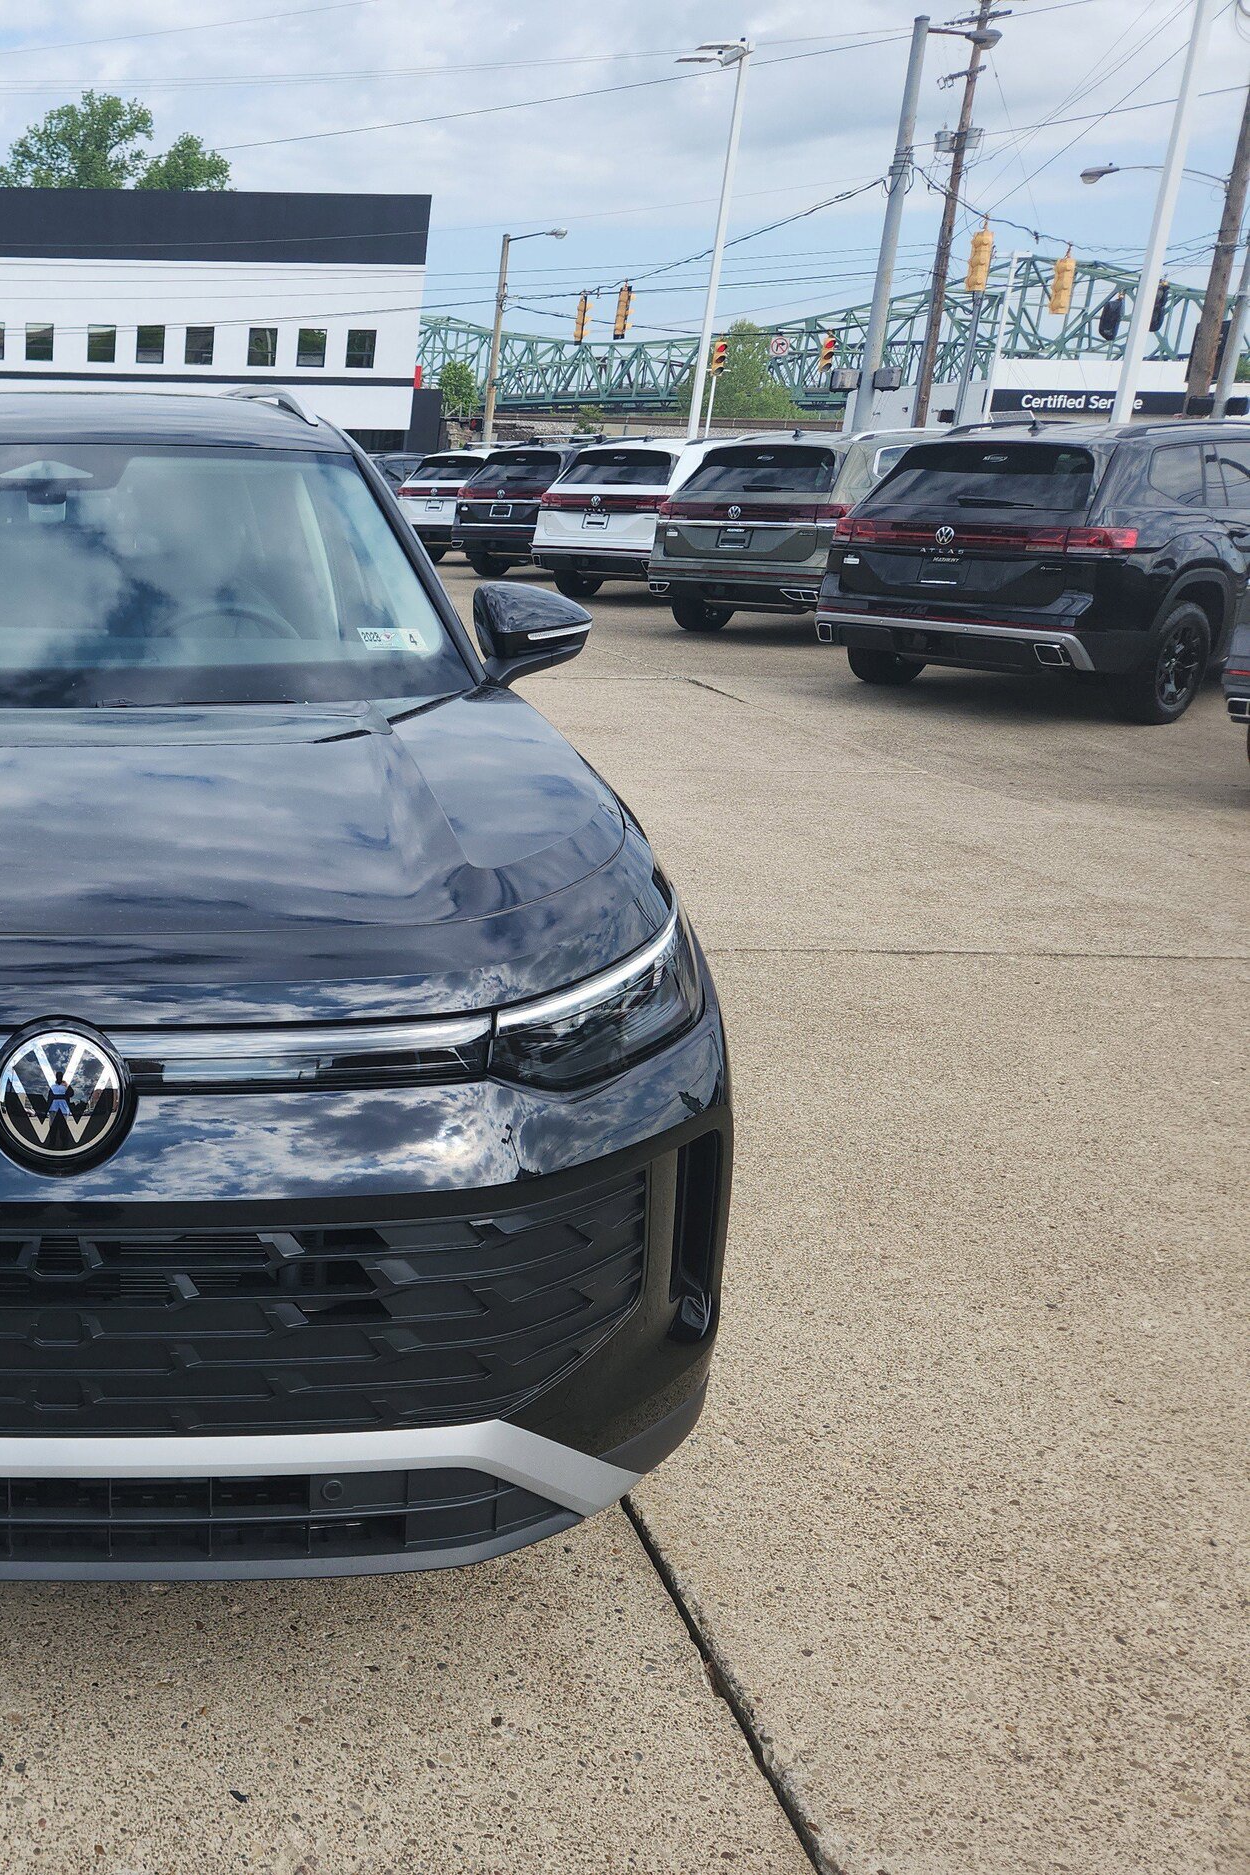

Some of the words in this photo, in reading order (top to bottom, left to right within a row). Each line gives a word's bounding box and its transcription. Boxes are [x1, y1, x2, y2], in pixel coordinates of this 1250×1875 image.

[1021, 394, 1085, 409] Certified
[1088, 395, 1144, 410] Sere
[919, 547, 965, 555] ATLAS
[408, 633, 418, 646] 4
